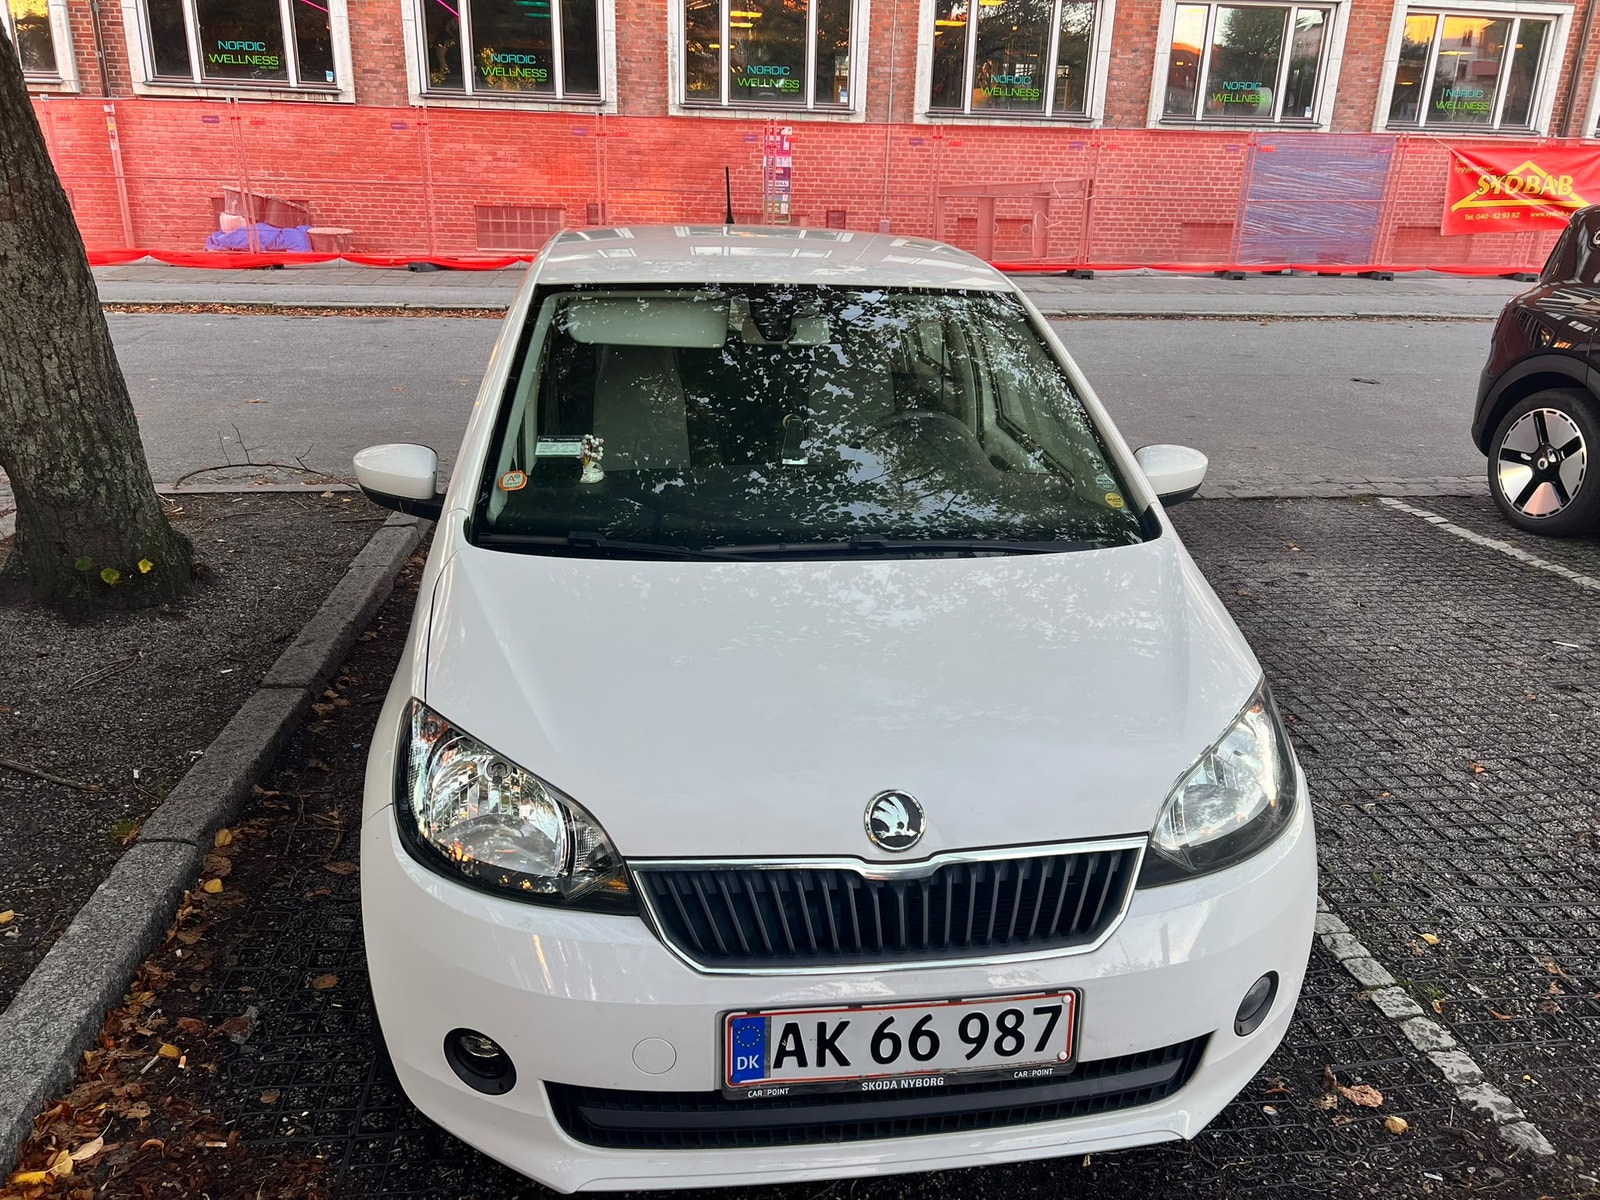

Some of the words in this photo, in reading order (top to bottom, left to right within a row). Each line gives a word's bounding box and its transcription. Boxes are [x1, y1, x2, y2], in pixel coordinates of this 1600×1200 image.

[217, 40, 266, 51] NORDIC
[208, 54, 279, 65] WELLNESS
[490, 53, 536, 64] NORDIC
[481, 66, 548, 78] WELLNESS
[747, 65, 790, 75] NORDIC
[737, 77, 800, 88] WELLNESS
[990, 74, 1032, 84] NORDIC
[1222, 81, 1263, 91] NORDIC
[981, 87, 1040, 97] WELLNESS
[1446, 89, 1484, 98] NORDIC
[1212, 93, 1270, 103] WELLNESS
[1436, 100, 1490, 110] WELLNESS
[772, 1020, 851, 1069] AK
[869, 1013, 941, 1065] 66
[957, 1005, 1063, 1061] 987
[736, 1055, 759, 1070] DK
[1013, 1070, 1028, 1078] CAR
[1032, 1068, 1053, 1076] POINT
[861, 1080, 898, 1091] SKODA
[900, 1077, 944, 1088] NYBORG
[747, 1090, 763, 1098] CAR
[767, 1087, 790, 1096] POINT
